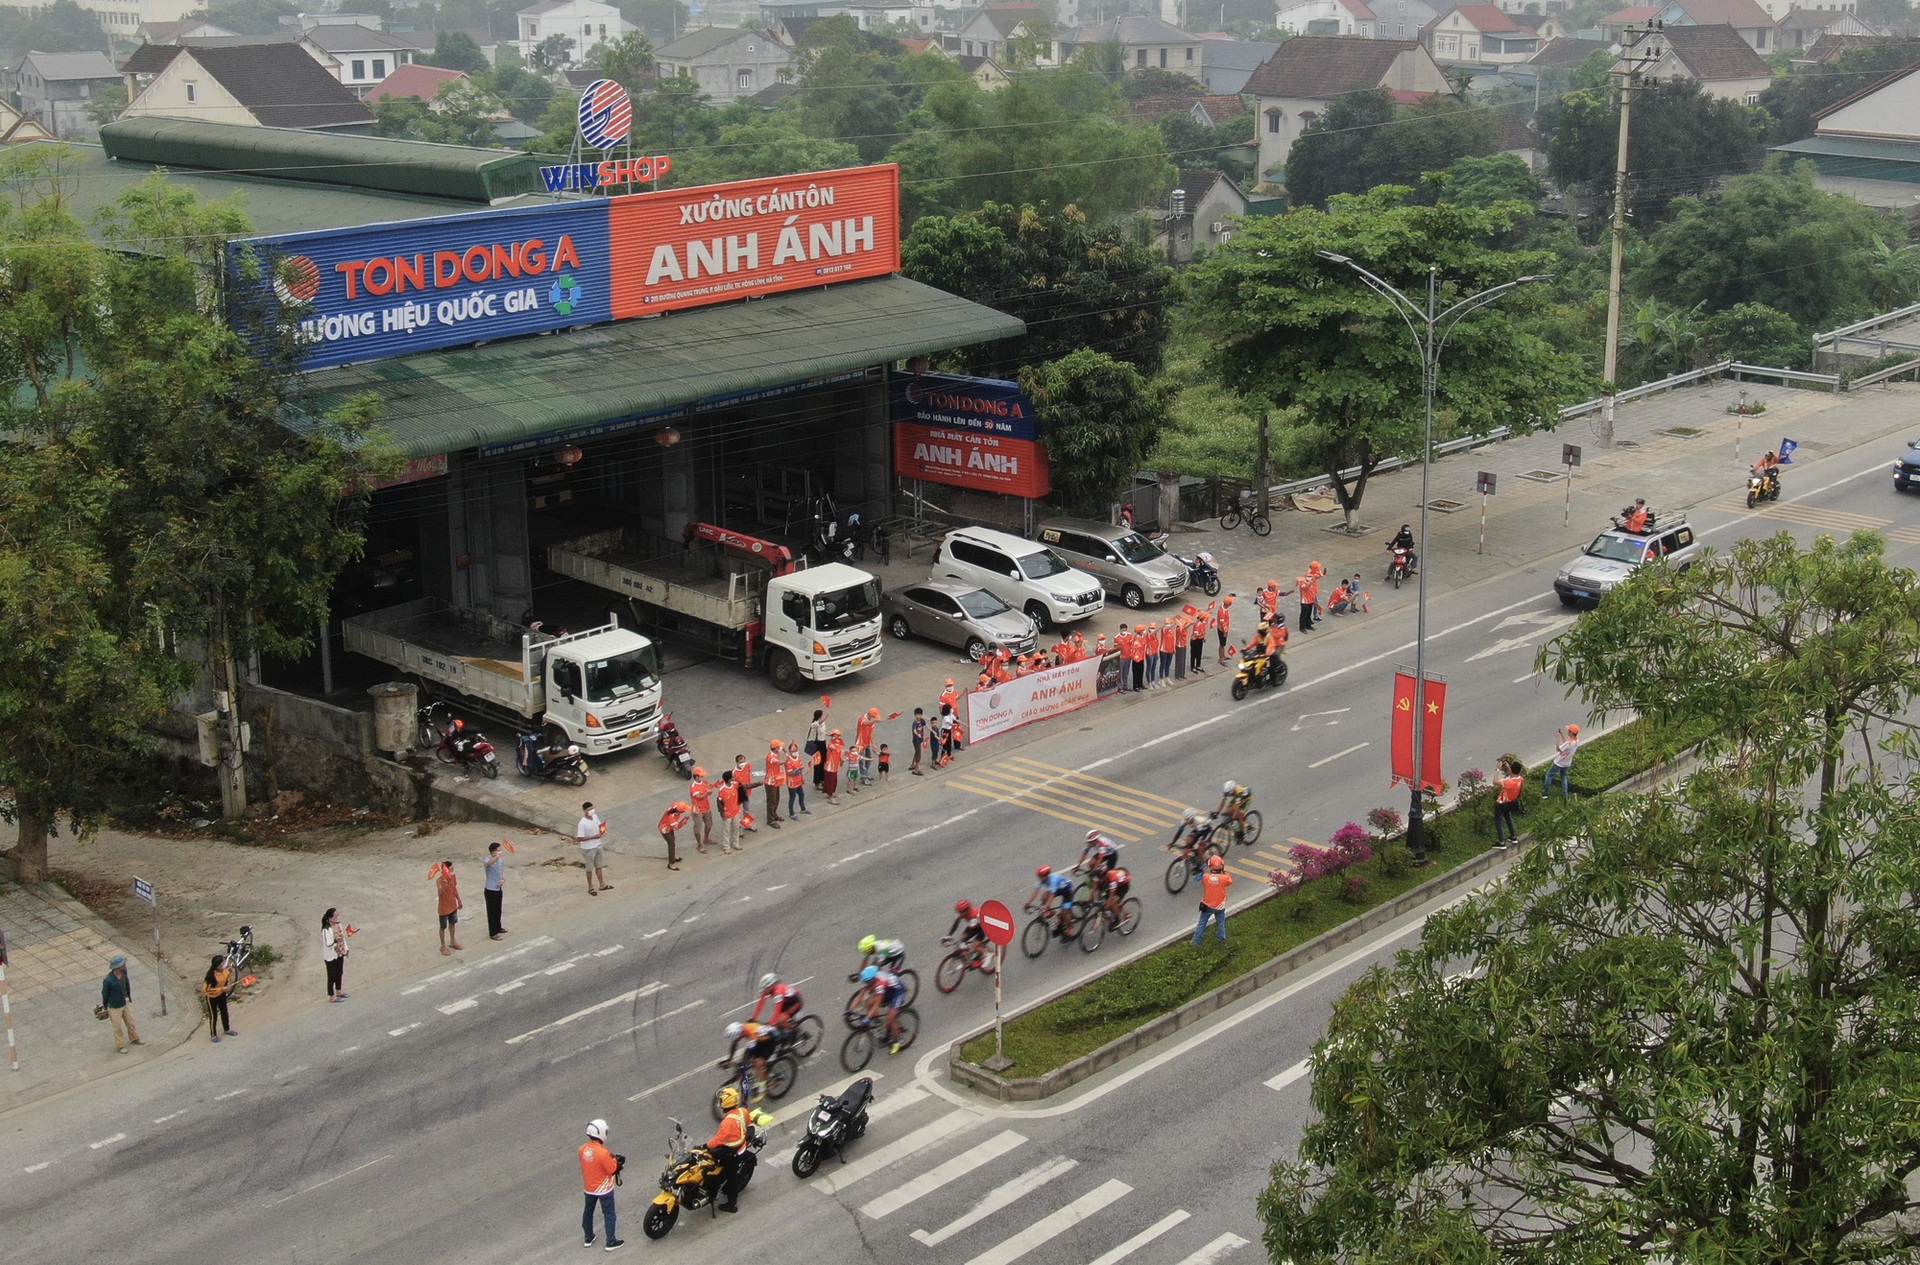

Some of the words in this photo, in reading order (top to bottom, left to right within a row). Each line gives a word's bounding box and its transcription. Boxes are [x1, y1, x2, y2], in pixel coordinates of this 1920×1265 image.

[679, 193, 753, 225] XƯỞNG
[645, 232, 758, 286] ANH
[772, 214, 874, 265] ÁNH
[335, 253, 425, 299] TON
[433, 238, 547, 288] DONG
[550, 235, 581, 271] A
[382, 301, 430, 334] HIỆU
[437, 289, 497, 326] QUỐC
[504, 288, 539, 313] GIA
[932, 412, 952, 423] HÀNH
[953, 415, 966, 425] LÊN
[984, 421, 994, 429] 50
[1010, 403, 1024, 419] A
[913, 442, 962, 466] ANH
[967, 447, 1018, 475] ÁNH
[1037, 674, 1050, 683] NHÀ
[1052, 671, 1066, 680] MÁY
[1067, 666, 1080, 676] TÔN
[1031, 687, 1056, 702] ANH
[1059, 679, 1082, 695] ÁNH
[1021, 708, 1038, 719] CHÀO
[1039, 703, 1060, 713] MỪNG
